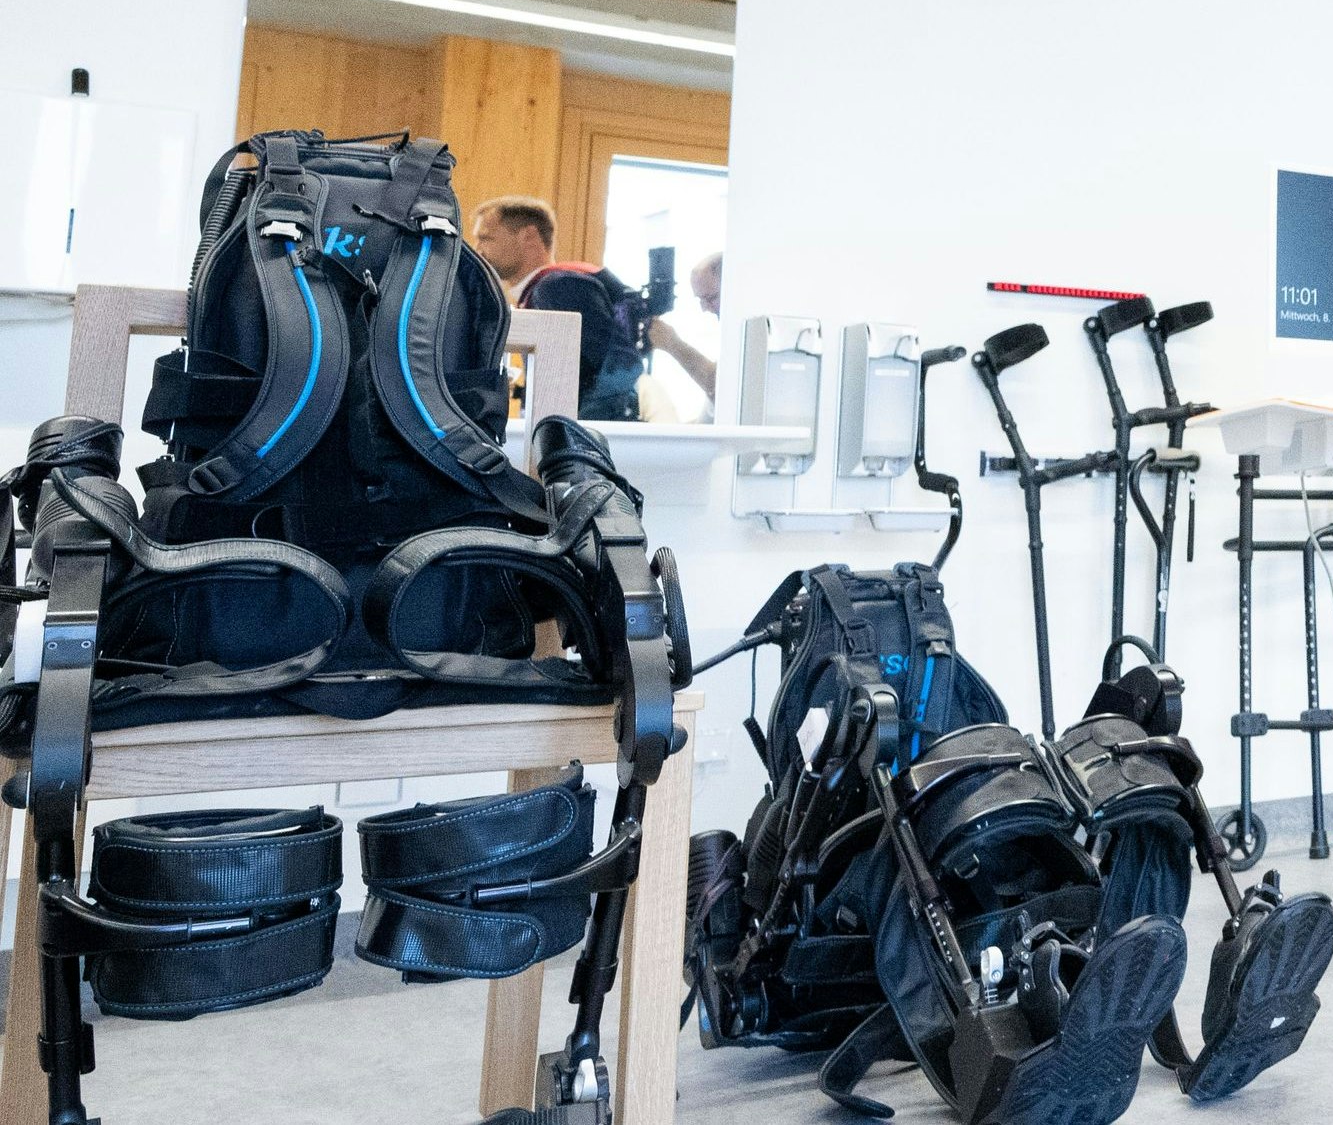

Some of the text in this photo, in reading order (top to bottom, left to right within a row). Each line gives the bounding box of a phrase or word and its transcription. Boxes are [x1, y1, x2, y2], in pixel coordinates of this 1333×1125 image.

[1281, 286, 1317, 305] 11:01
[1280, 310, 1321, 323] Mittwoch,
[1323, 313, 1331, 323] 8.
